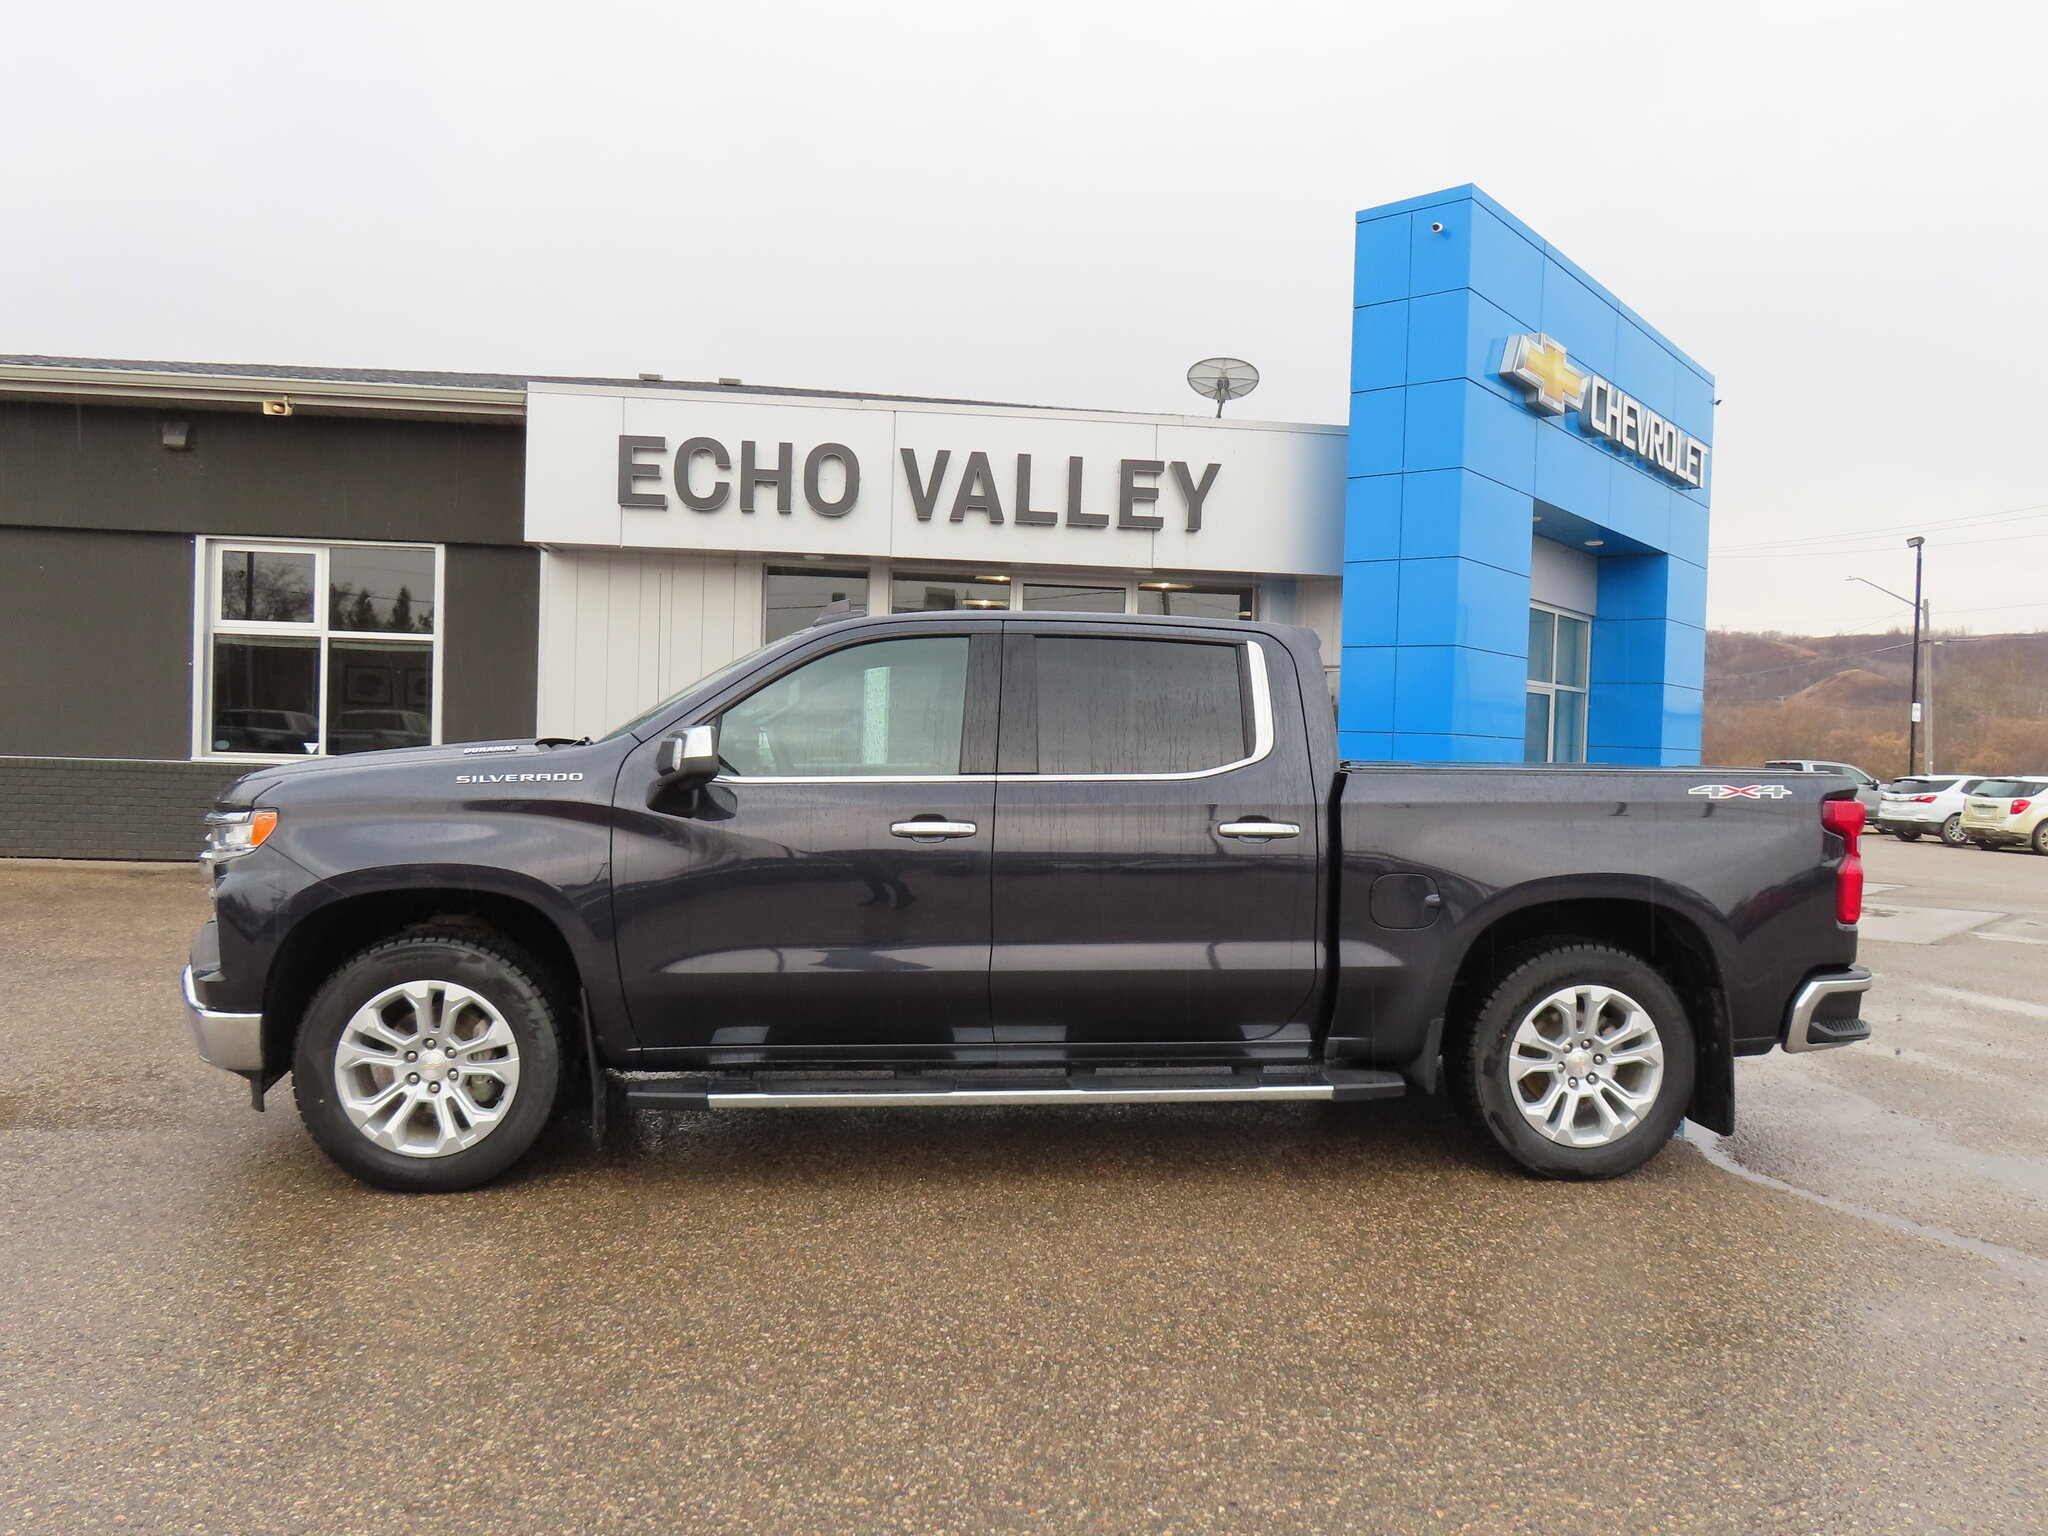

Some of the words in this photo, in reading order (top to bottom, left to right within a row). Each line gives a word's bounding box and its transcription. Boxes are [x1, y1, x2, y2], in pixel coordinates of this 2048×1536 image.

[1588, 374, 1709, 489] CHEVROLET
[617, 435, 861, 518] ECHO
[900, 447, 1221, 532] VALLEY
[463, 745, 518, 754] DURAMAX
[456, 772, 584, 784] SILVERADO
[1688, 785, 1792, 799] 4X4
